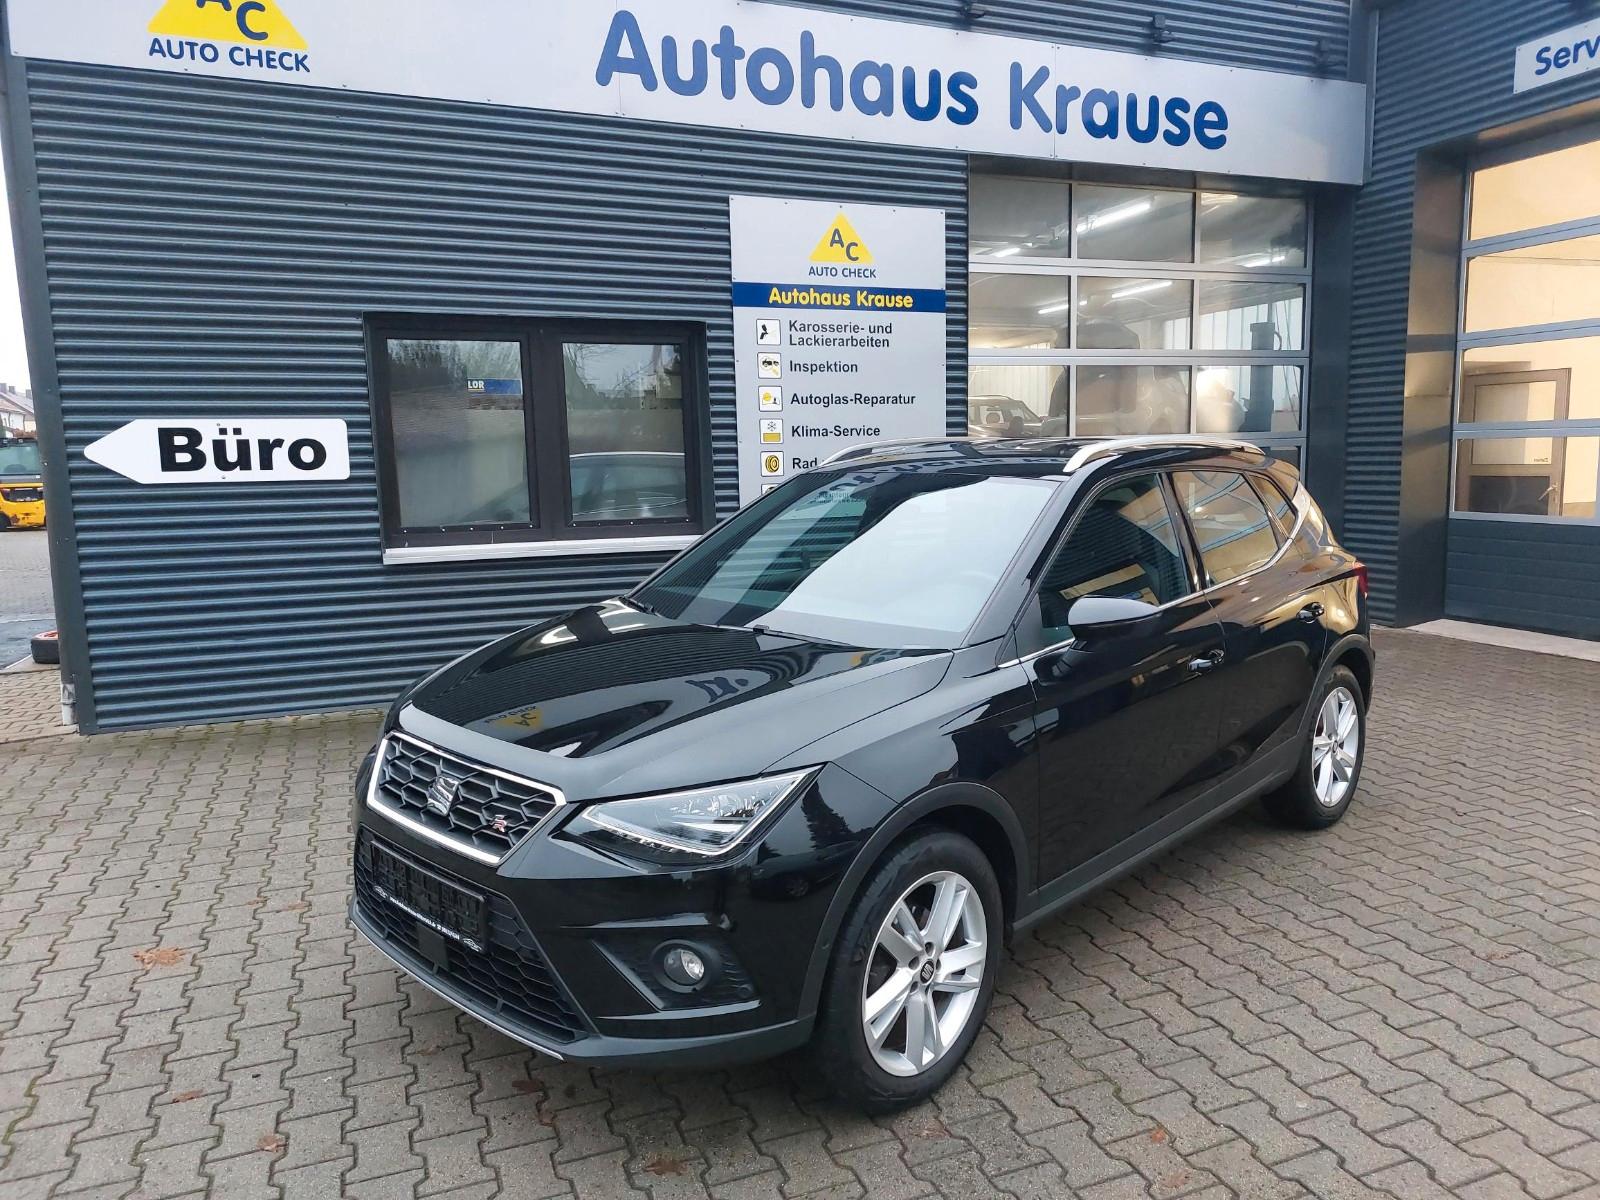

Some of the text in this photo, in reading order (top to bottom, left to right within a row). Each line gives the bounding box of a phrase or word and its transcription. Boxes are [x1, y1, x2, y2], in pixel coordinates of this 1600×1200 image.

[149, 37, 311, 73] AUTO CHECK
[1535, 35, 1600, 76] Serv
[595, 9, 1229, 150] Autohaus Krause
[808, 266, 877, 279] AUTO CHECK
[768, 286, 914, 308] Autohaus Krause
[788, 320, 893, 335] Karosserie- und
[789, 334, 890, 348] Lackierarbeiten
[789, 360, 859, 374] Inspektion
[467, 380, 485, 390] LOR
[790, 392, 916, 407] Autoglas-Reparatur
[791, 425, 881, 438] Klima-Service
[157, 426, 328, 472] Büro
